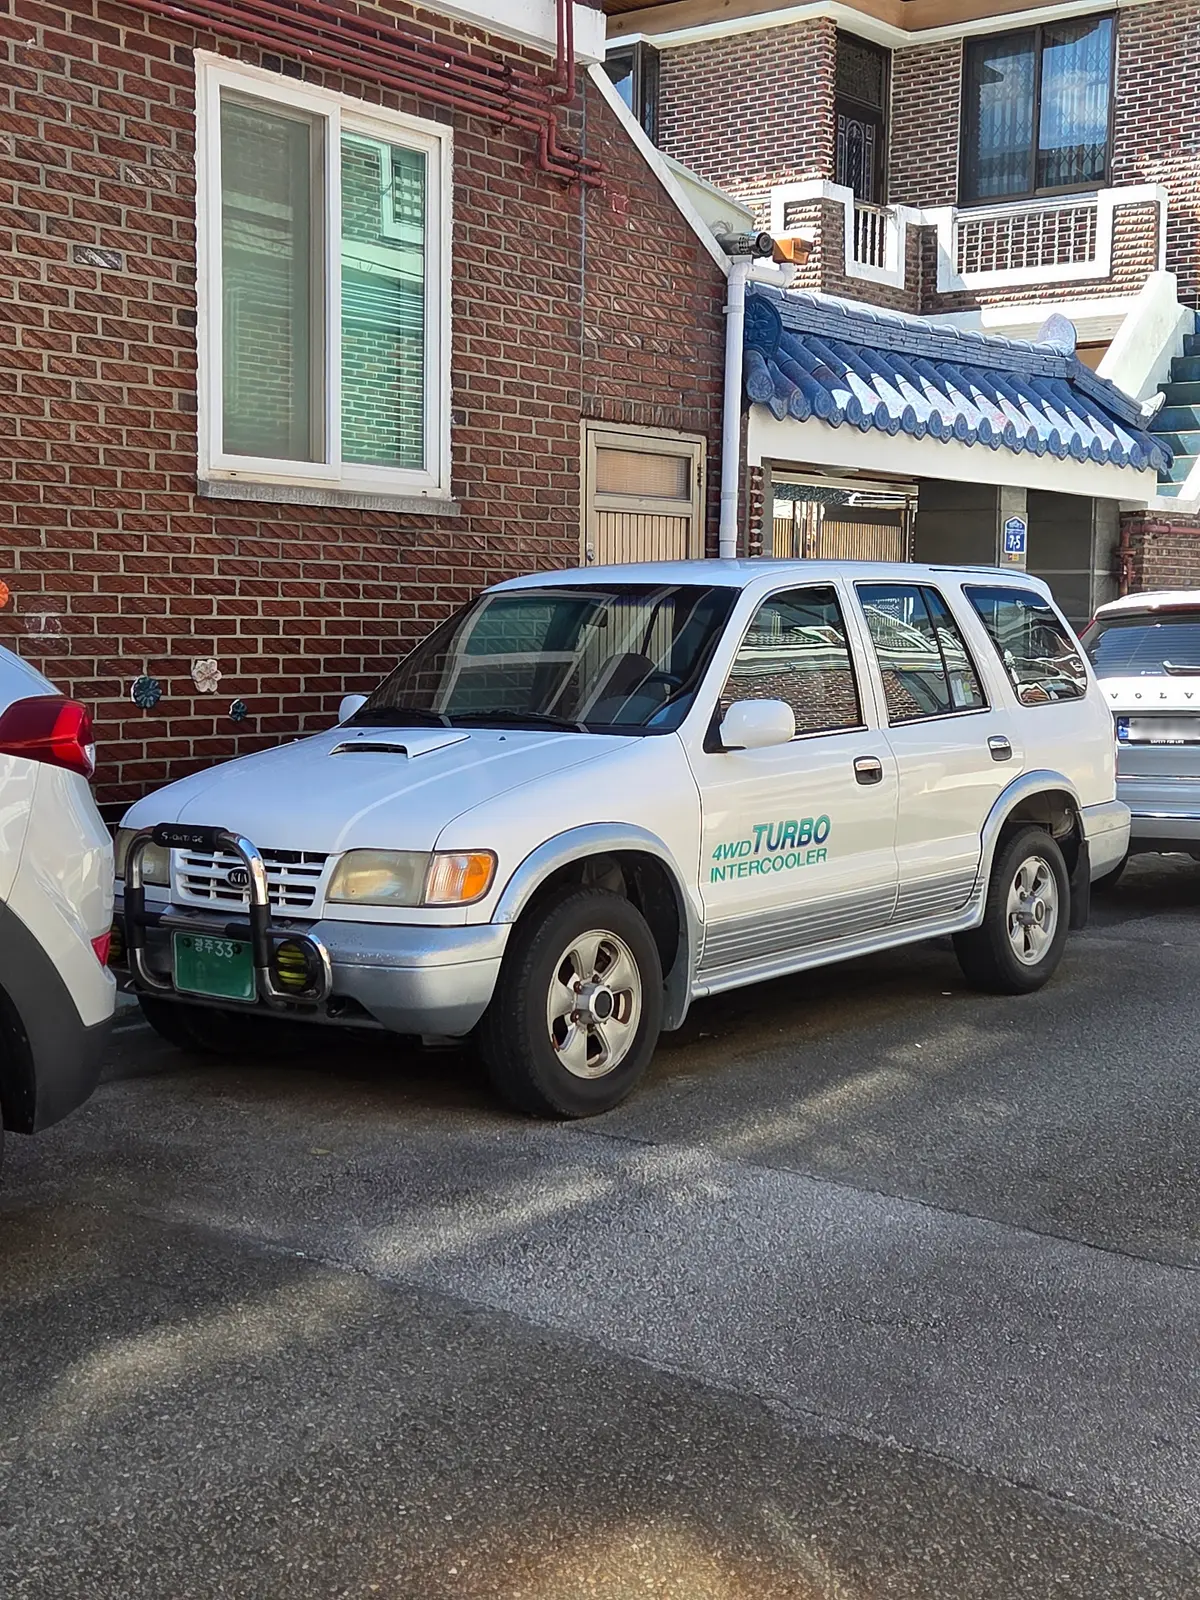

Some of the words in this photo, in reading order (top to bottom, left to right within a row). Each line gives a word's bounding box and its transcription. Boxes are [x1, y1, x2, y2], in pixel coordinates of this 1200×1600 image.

[712, 840, 752, 861] 4WD
[752, 814, 831, 855] TURBO
[230, 872, 248, 883] KIA
[710, 848, 828, 883] INTERCOOLER
